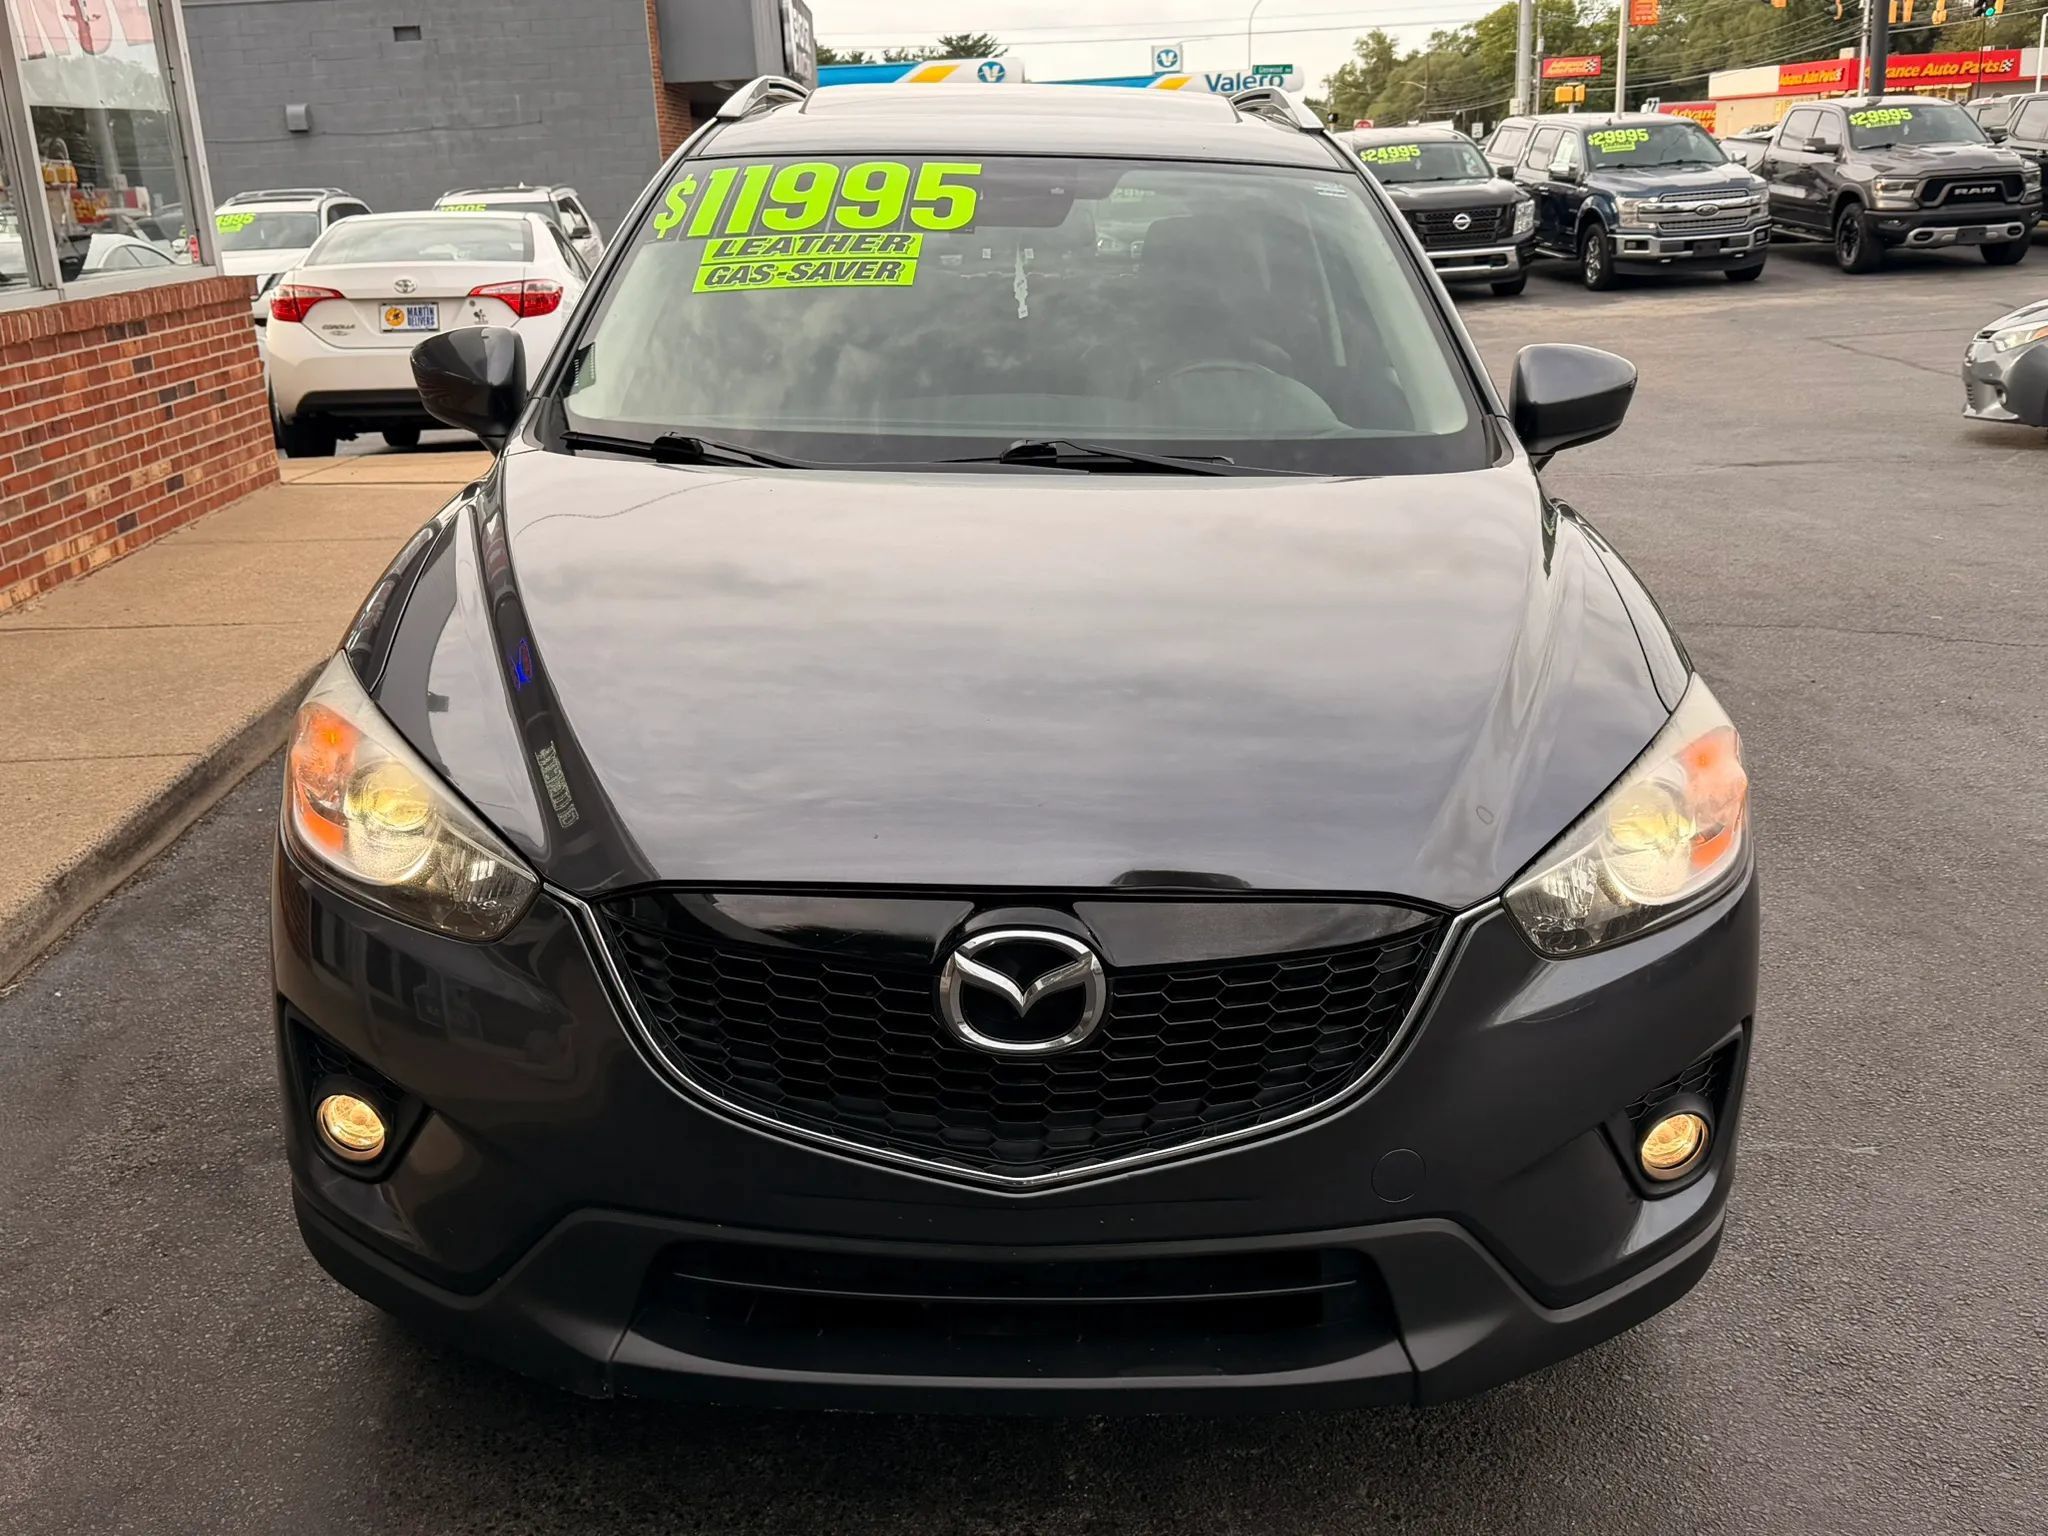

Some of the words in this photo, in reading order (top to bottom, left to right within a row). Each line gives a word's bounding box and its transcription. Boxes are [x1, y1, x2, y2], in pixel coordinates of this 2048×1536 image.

[1920, 63, 1959, 77] Auto
[1960, 60, 1999, 74] Parts
[1204, 73, 1284, 92] Valero
[1848, 108, 1912, 125] $29995
[1587, 129, 1649, 145] $29995
[1360, 145, 1421, 161] $24995
[1954, 187, 1996, 195] RAM
[653, 161, 982, 239] $11995
[711, 233, 915, 259] LEATHER
[703, 261, 905, 286] GAS-SAVER
[407, 307, 435, 316] MARTIN
